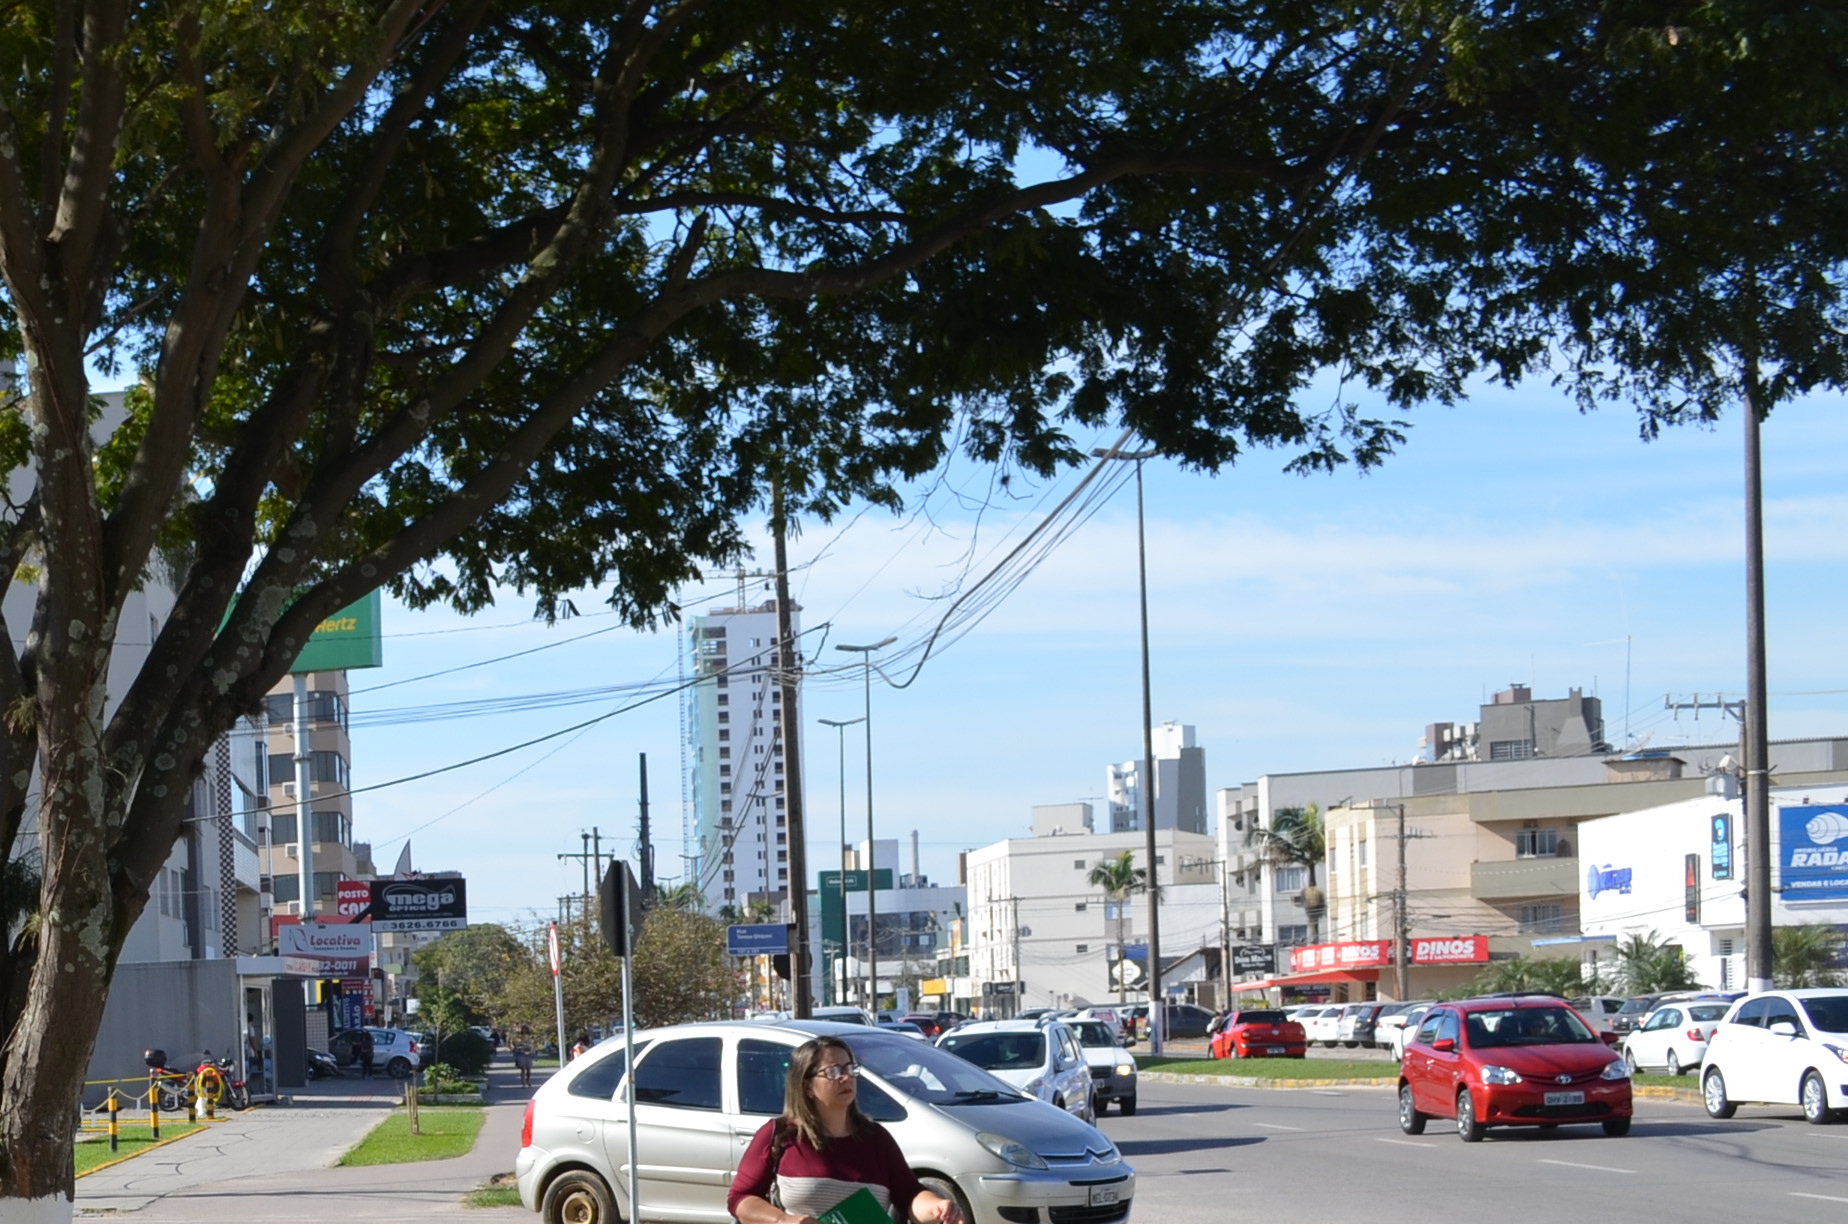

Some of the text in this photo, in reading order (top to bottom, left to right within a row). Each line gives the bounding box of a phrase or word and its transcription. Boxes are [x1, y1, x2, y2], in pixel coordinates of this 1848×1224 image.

[338, 889, 369, 899] POSTO
[389, 920, 458, 931] 3626.6766
[310, 934, 362, 947] Locativa
[1416, 939, 1476, 956] DINOS
